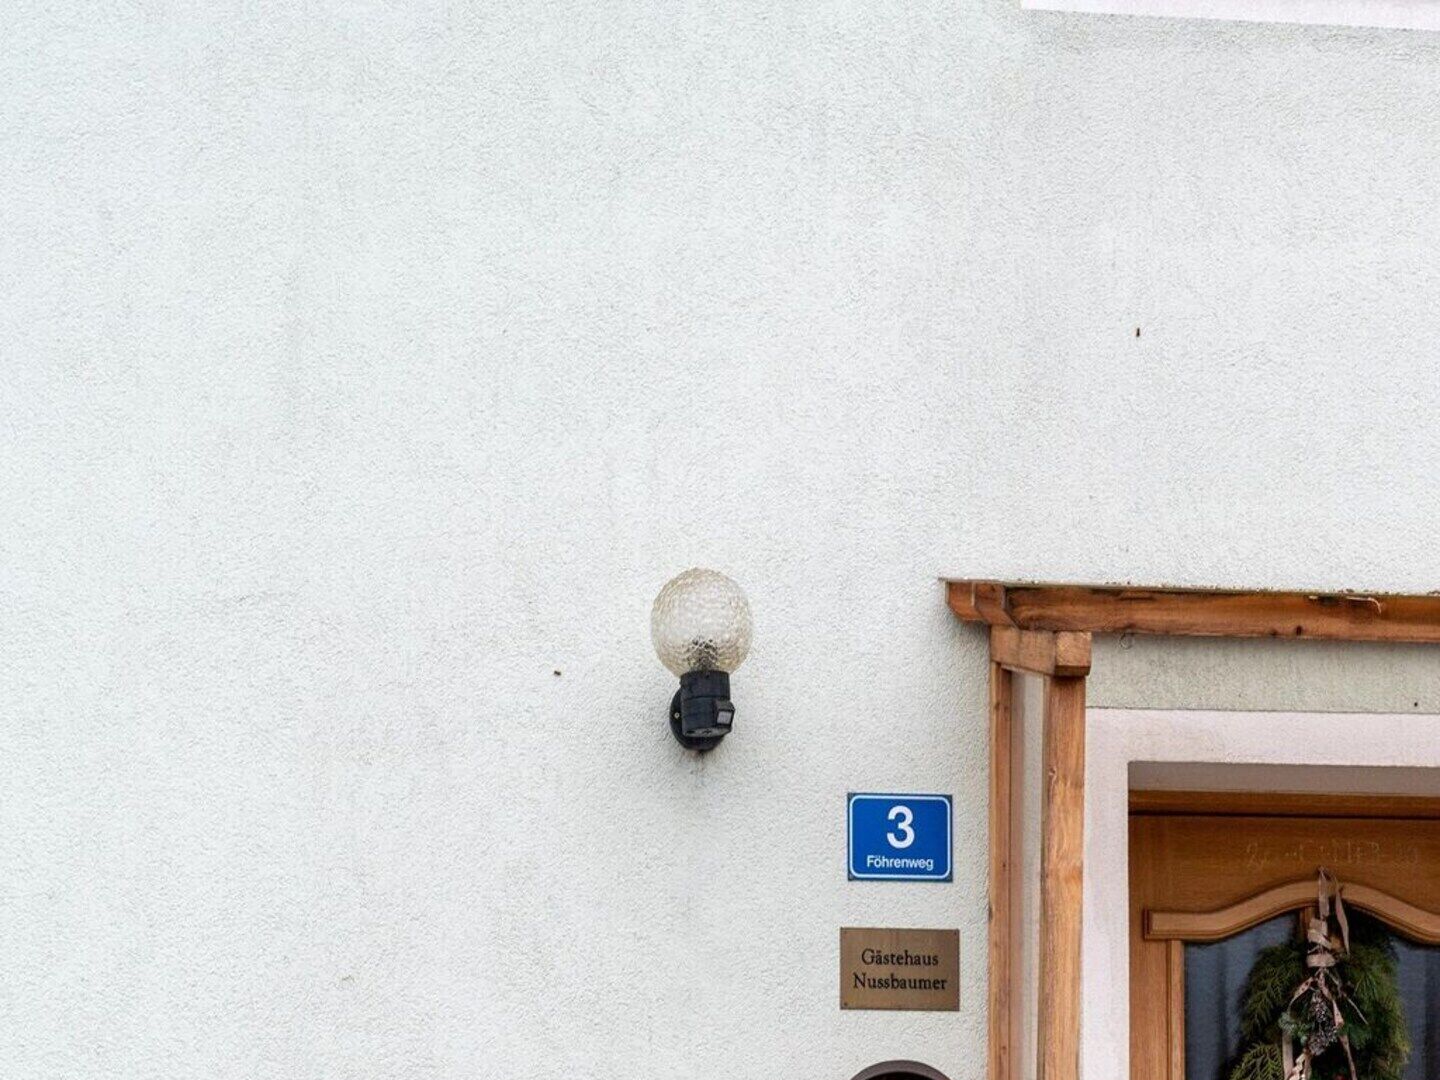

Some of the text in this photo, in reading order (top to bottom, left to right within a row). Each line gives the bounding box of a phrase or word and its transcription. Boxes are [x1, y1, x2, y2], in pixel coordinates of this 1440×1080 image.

[886, 805, 915, 849] 3
[866, 854, 934, 871] Föhrenweg
[861, 948, 939, 966] Gästehaus
[853, 971, 948, 990] Nussbaumer
